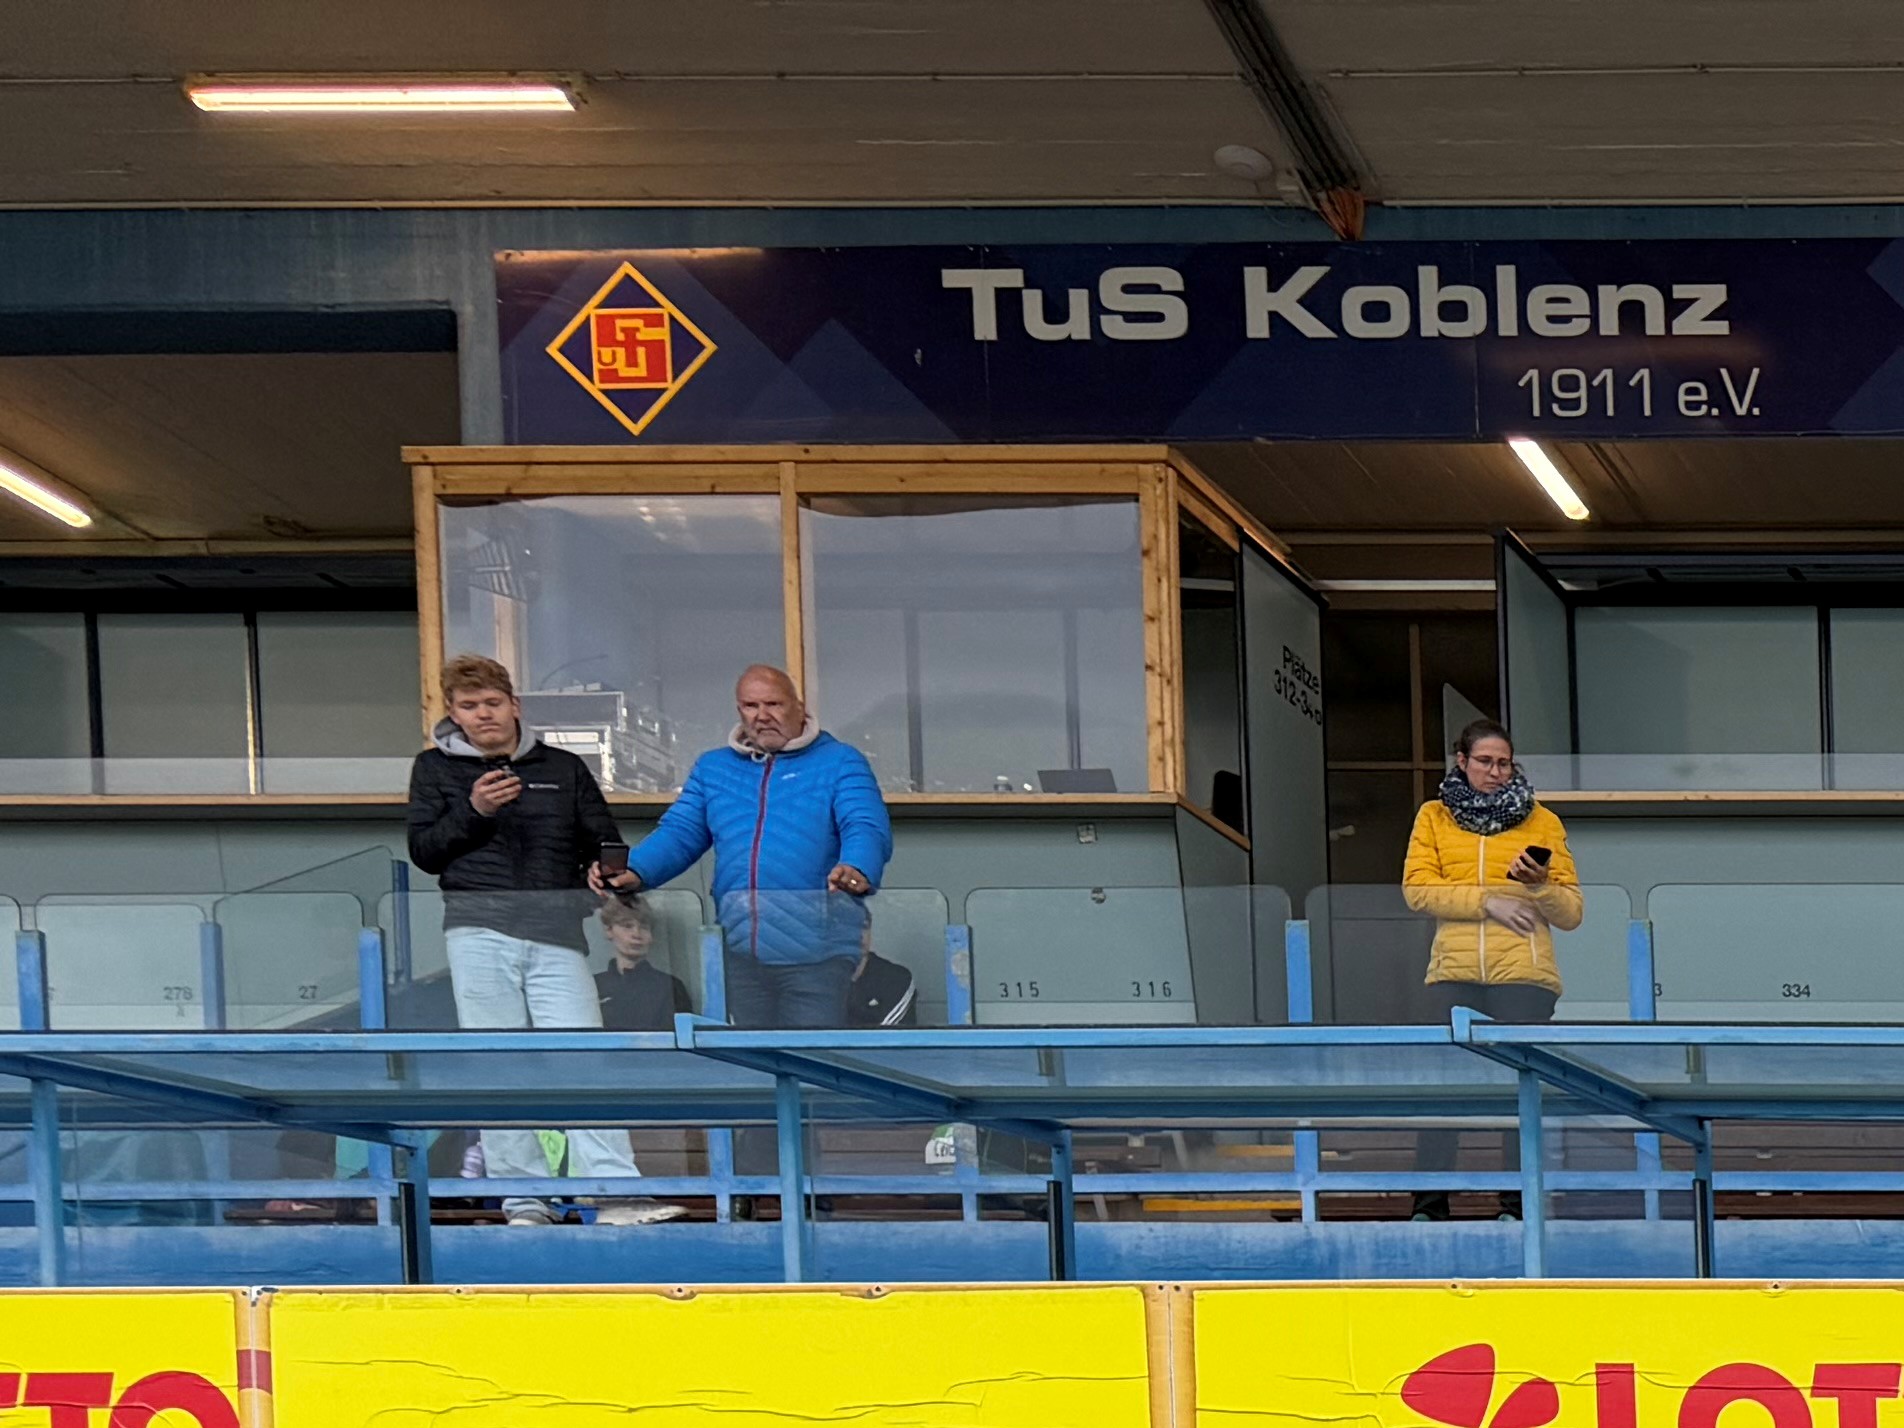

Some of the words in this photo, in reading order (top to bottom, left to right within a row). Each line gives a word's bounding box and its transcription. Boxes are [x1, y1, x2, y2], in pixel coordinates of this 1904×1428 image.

[941, 265, 1189, 343] TuS
[1244, 262, 1730, 340] Koblenz
[1517, 367, 1654, 419] 1911
[1676, 366, 1762, 418] e.V.
[999, 980, 1040, 998] 315
[1131, 980, 1172, 998] 316
[1781, 982, 1812, 999] 334
